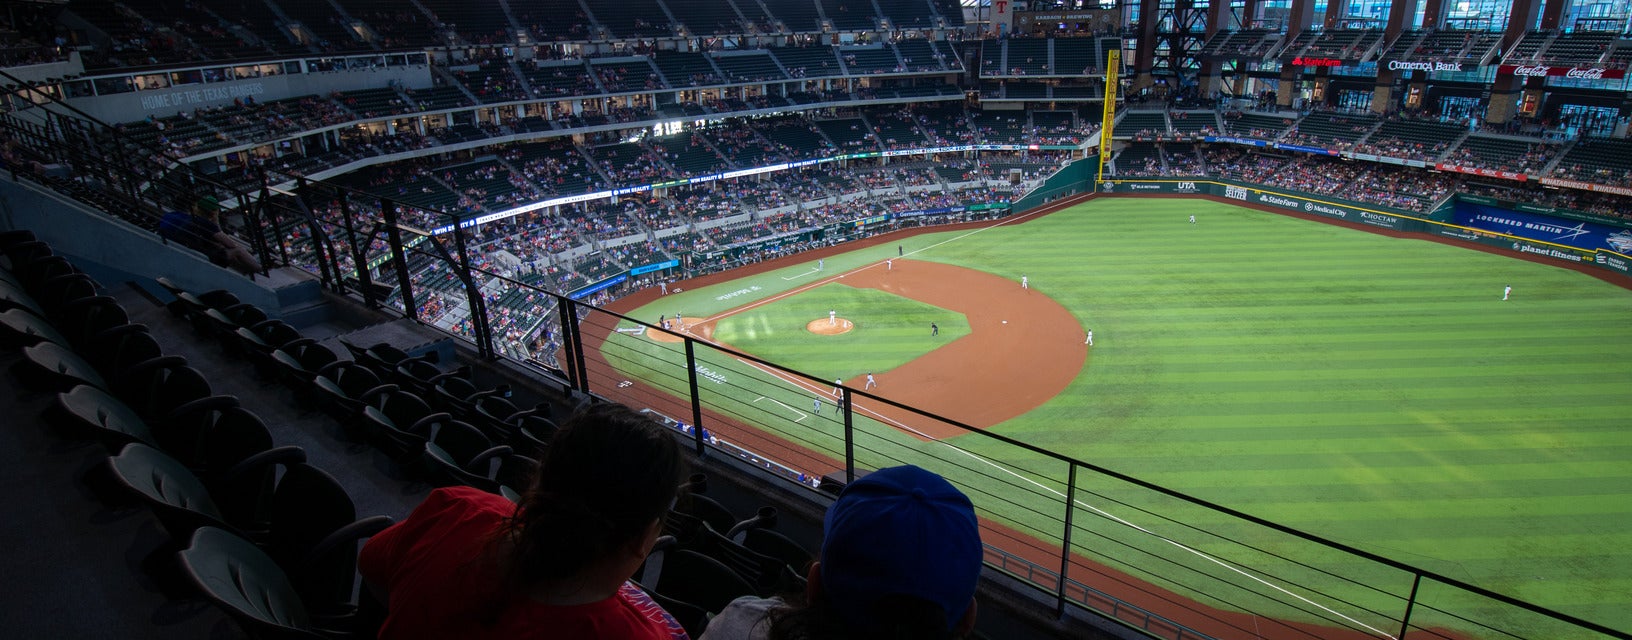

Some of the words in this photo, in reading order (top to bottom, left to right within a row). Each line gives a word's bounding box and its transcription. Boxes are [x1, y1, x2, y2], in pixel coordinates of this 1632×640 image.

[996, 1, 1007, 13] T
[1435, 62, 1462, 71] Bank
[141, 94, 171, 110] HOME
[171, 92, 183, 106] OF
[184, 90, 202, 103] THE
[202, 86, 229, 101] TEXAS
[230, 82, 264, 98] RANGERS
[631, 185, 650, 193] REALITY
[1541, 177, 1589, 190] WHATABURGER
[1225, 189, 1247, 201] SELTZER
[1362, 212, 1398, 223] CHOCTAW
[1476, 214, 1522, 227] LOCKHEED
[1524, 222, 1562, 234] MARTIN
[434, 226, 447, 235] WIN
[1520, 245, 1549, 256] planet
[1550, 248, 1582, 261] fitness
